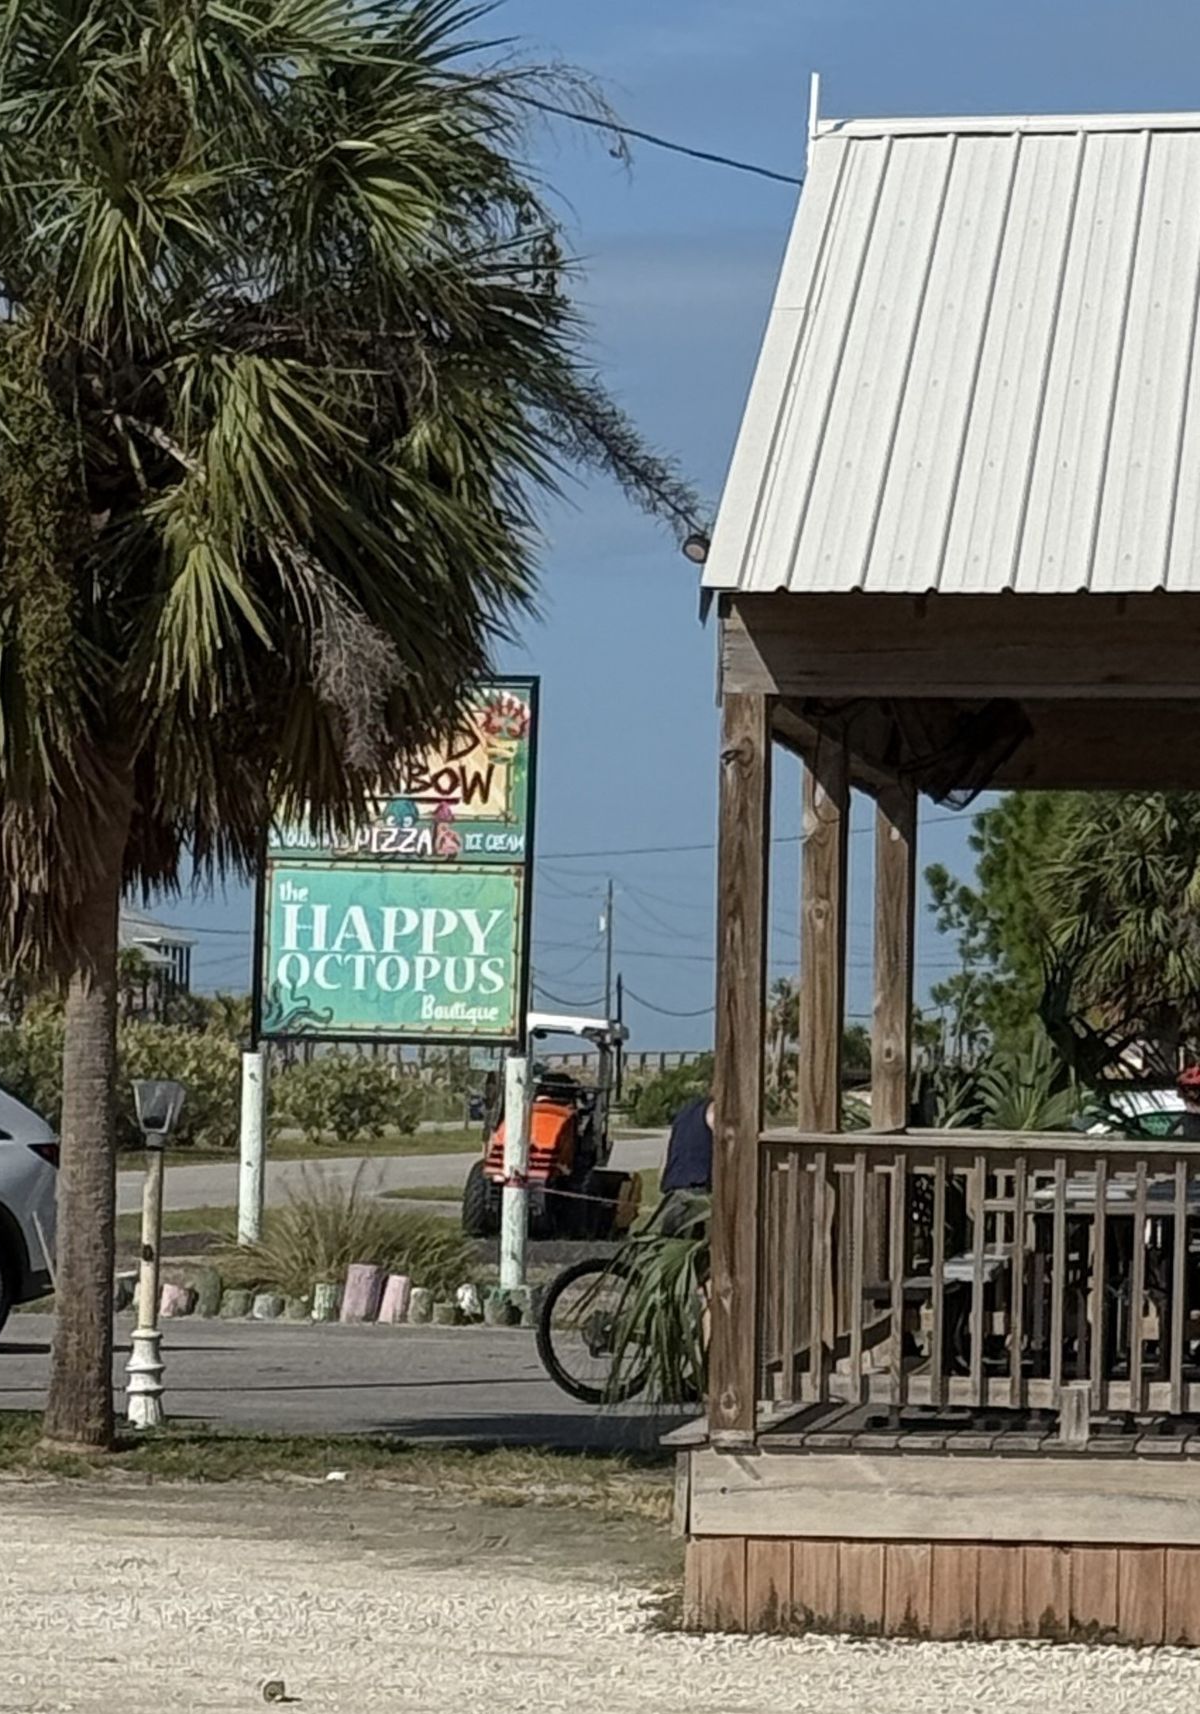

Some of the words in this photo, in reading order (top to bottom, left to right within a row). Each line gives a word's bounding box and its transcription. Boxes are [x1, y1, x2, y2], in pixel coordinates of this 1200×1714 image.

[353, 821, 433, 856] PIZZA
[464, 832, 484, 851] ICE
[279, 879, 309, 902] the
[280, 903, 505, 957] HAPPY
[277, 952, 505, 995] OCTOPUS
[420, 994, 499, 1025] Boutique
